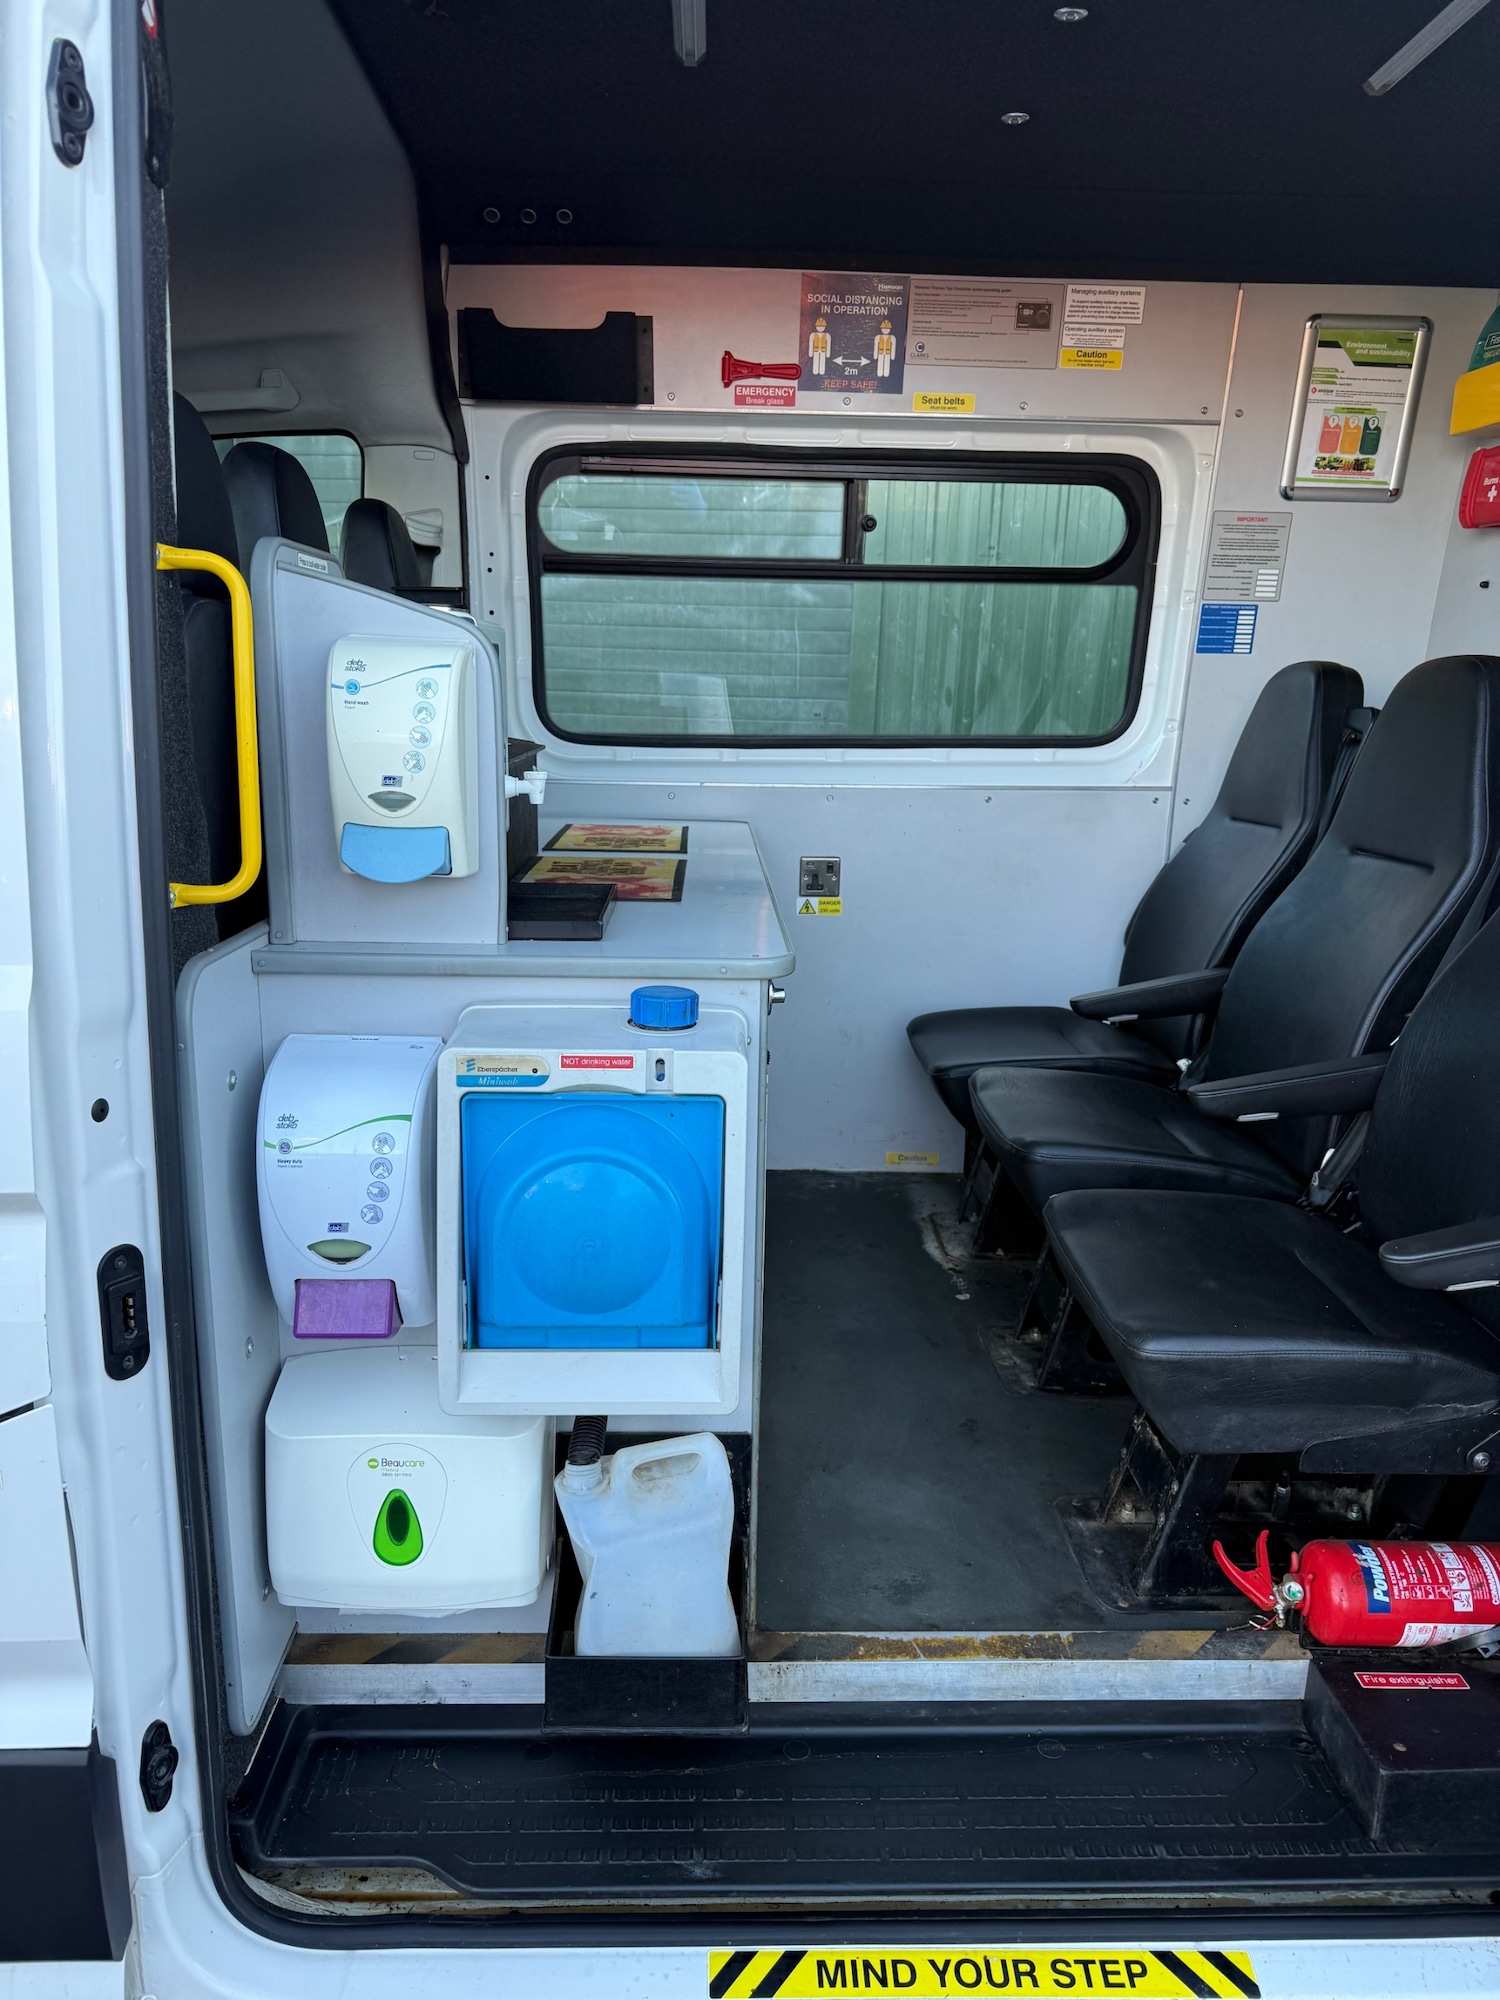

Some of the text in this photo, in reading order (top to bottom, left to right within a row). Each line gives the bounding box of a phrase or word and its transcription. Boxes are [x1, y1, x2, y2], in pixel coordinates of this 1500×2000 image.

[1071, 288, 1097, 296] Managing
[807, 293, 903, 306] SOCIAL DISTANCING
[821, 304, 888, 316] IN OPERATION
[1064, 325, 1087, 333] Operating
[1346, 340, 1387, 349] Environment
[1076, 349, 1108, 359] Caution
[1369, 349, 1412, 358] sustainability
[844, 366, 858, 376] 2m
[824, 379, 877, 389] KEEP SAFE!
[736, 386, 795, 397] EMERGENCY
[745, 396, 784, 406] Break glass
[921, 395, 966, 405] Seat belts
[346, 658, 364, 666] deb
[344, 664, 367, 672] stoko
[562, 1057, 632, 1067] NOT drinking water
[477, 1076, 519, 1086] Miniwash
[278, 1113, 295, 1122] deb
[276, 1119, 299, 1129] stoko
[898, 1153, 928, 1162] Caution
[381, 1457, 425, 1468] Beaucare
[1361, 1544, 1391, 1603] Powder
[1377, 1546, 1400, 1600] FIRE EXTINGUISHER
[1447, 1569, 1456, 1578] B
[1453, 1591, 1462, 1600] A
[1362, 1674, 1459, 1687] Fire extinguisher
[815, 1958, 1148, 1989] MIND YOUR STEP
